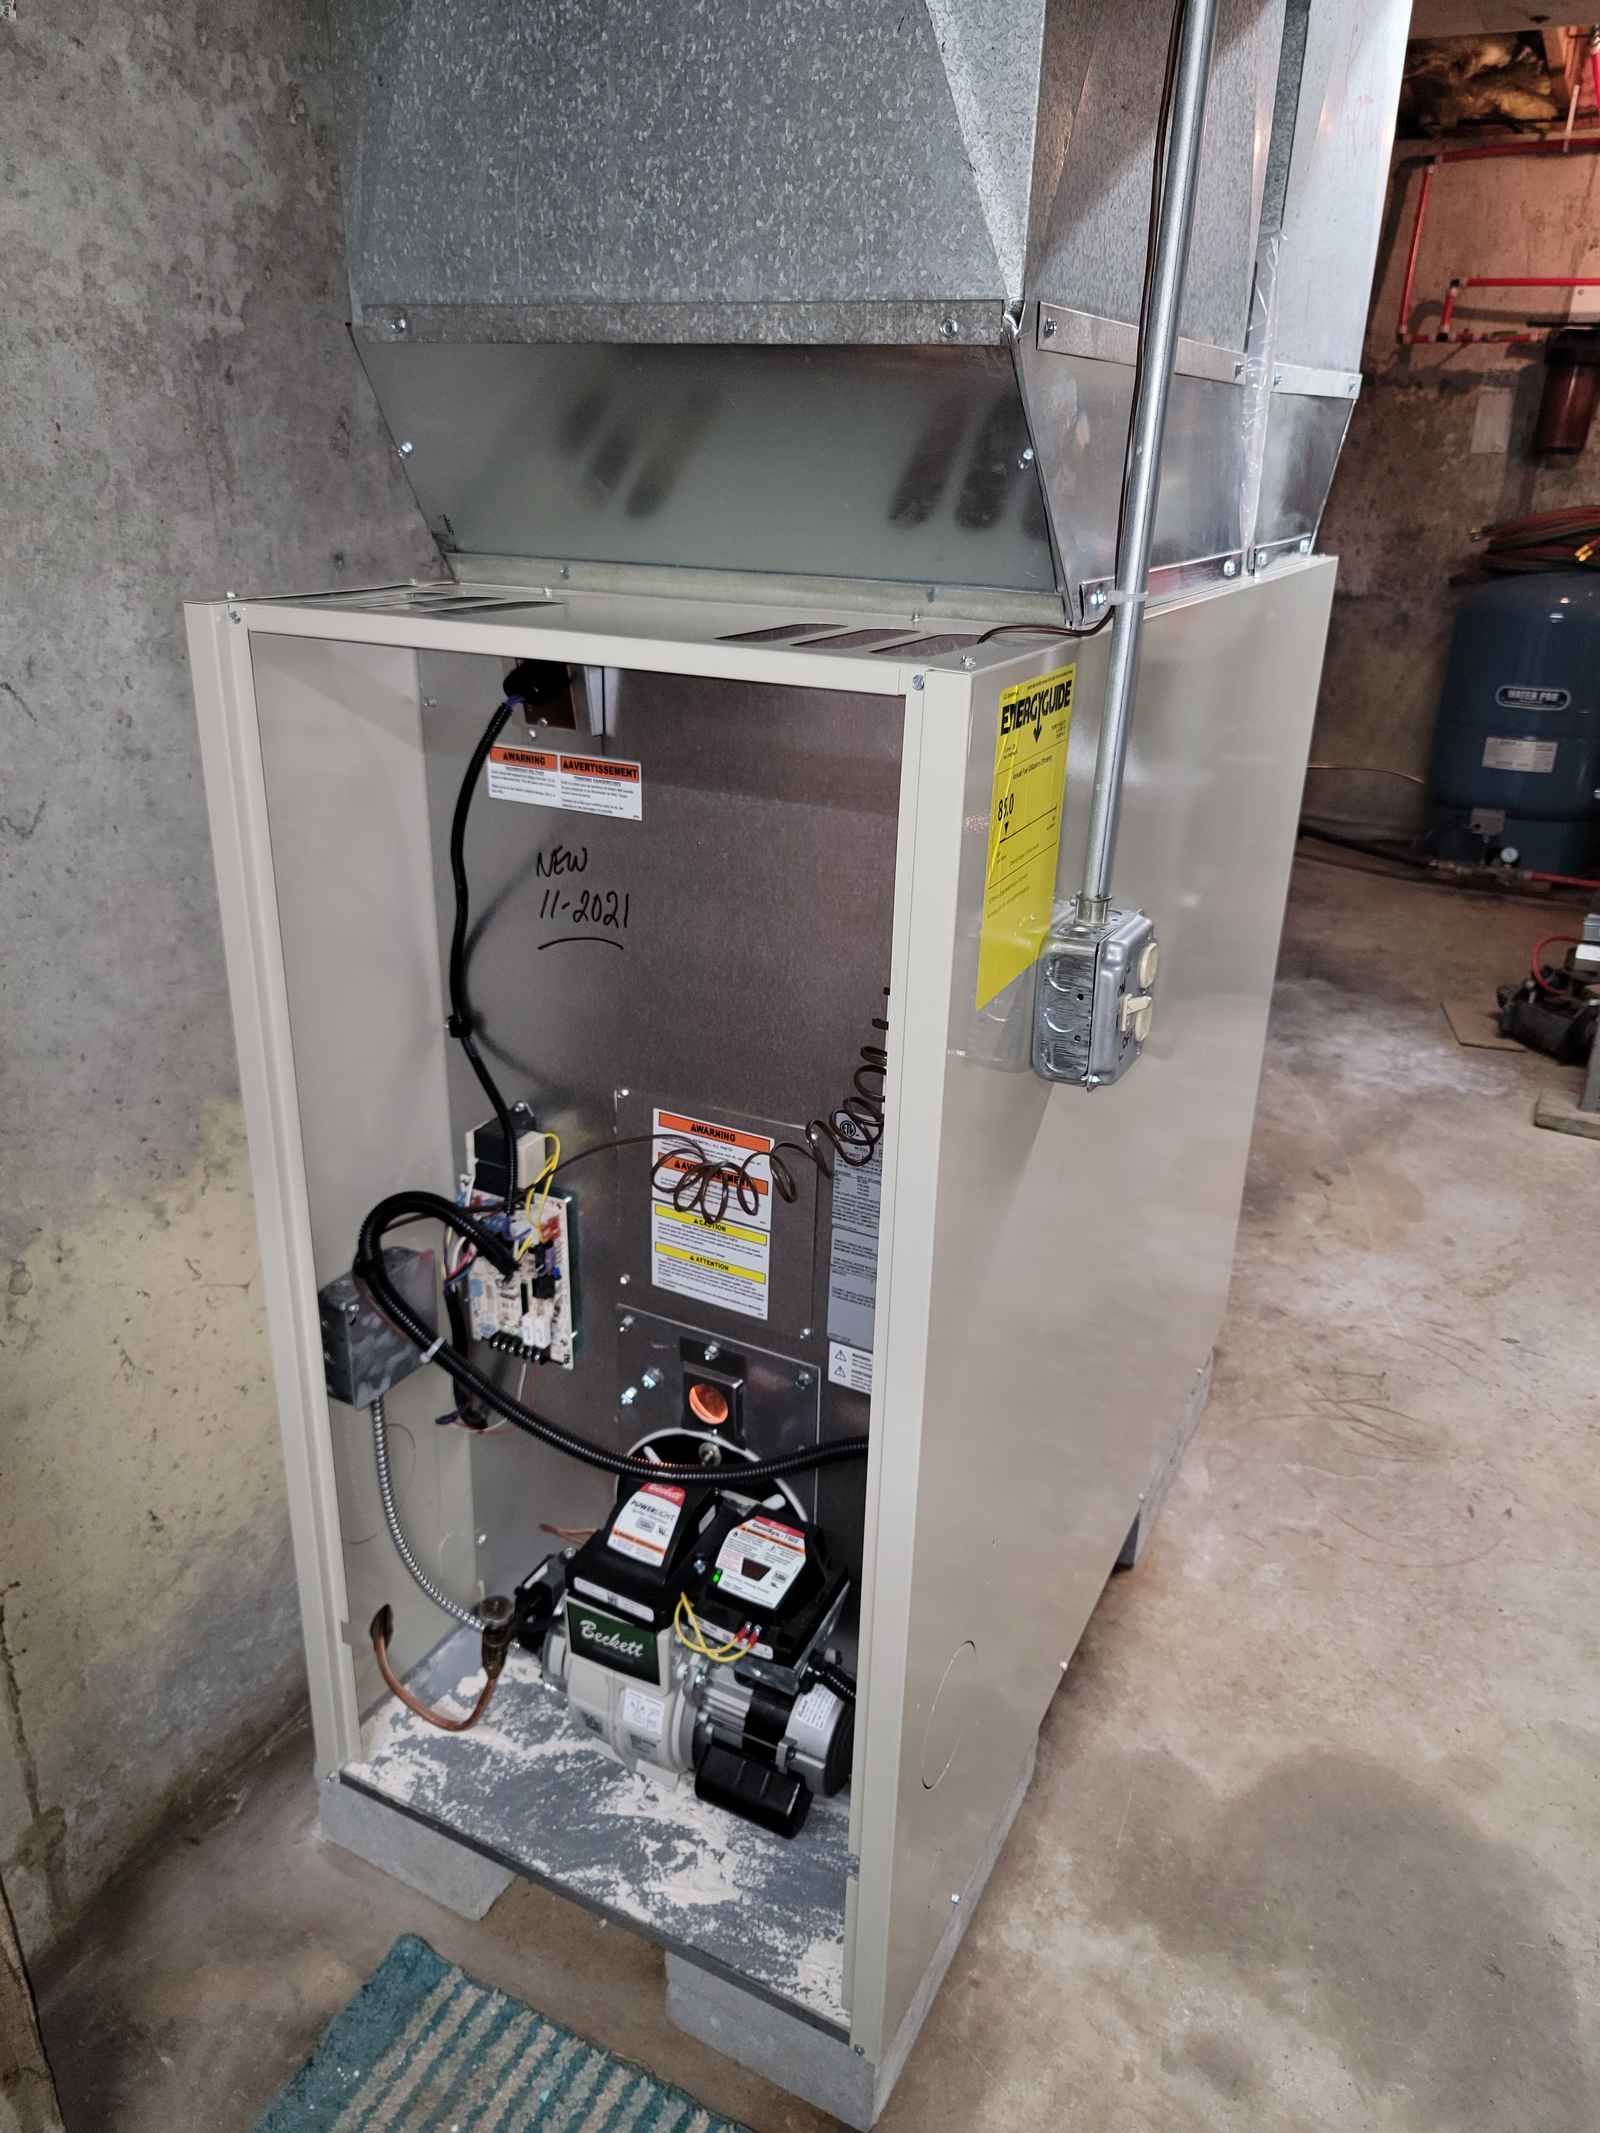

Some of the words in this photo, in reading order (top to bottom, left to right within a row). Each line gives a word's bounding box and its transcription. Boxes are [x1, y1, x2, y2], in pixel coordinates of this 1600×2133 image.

[1000, 680, 1072, 737] ENERGYGUIDE
[508, 753, 546, 766] WARNING
[568, 760, 638, 779] AVERTISSEMENT
[536, 845, 588, 877] NEW
[540, 889, 630, 929] 11-2021
[696, 1126, 736, 1143] WARNING
[696, 1256, 729, 1271] ATTENTION
[579, 1619, 644, 1657] Beckett
